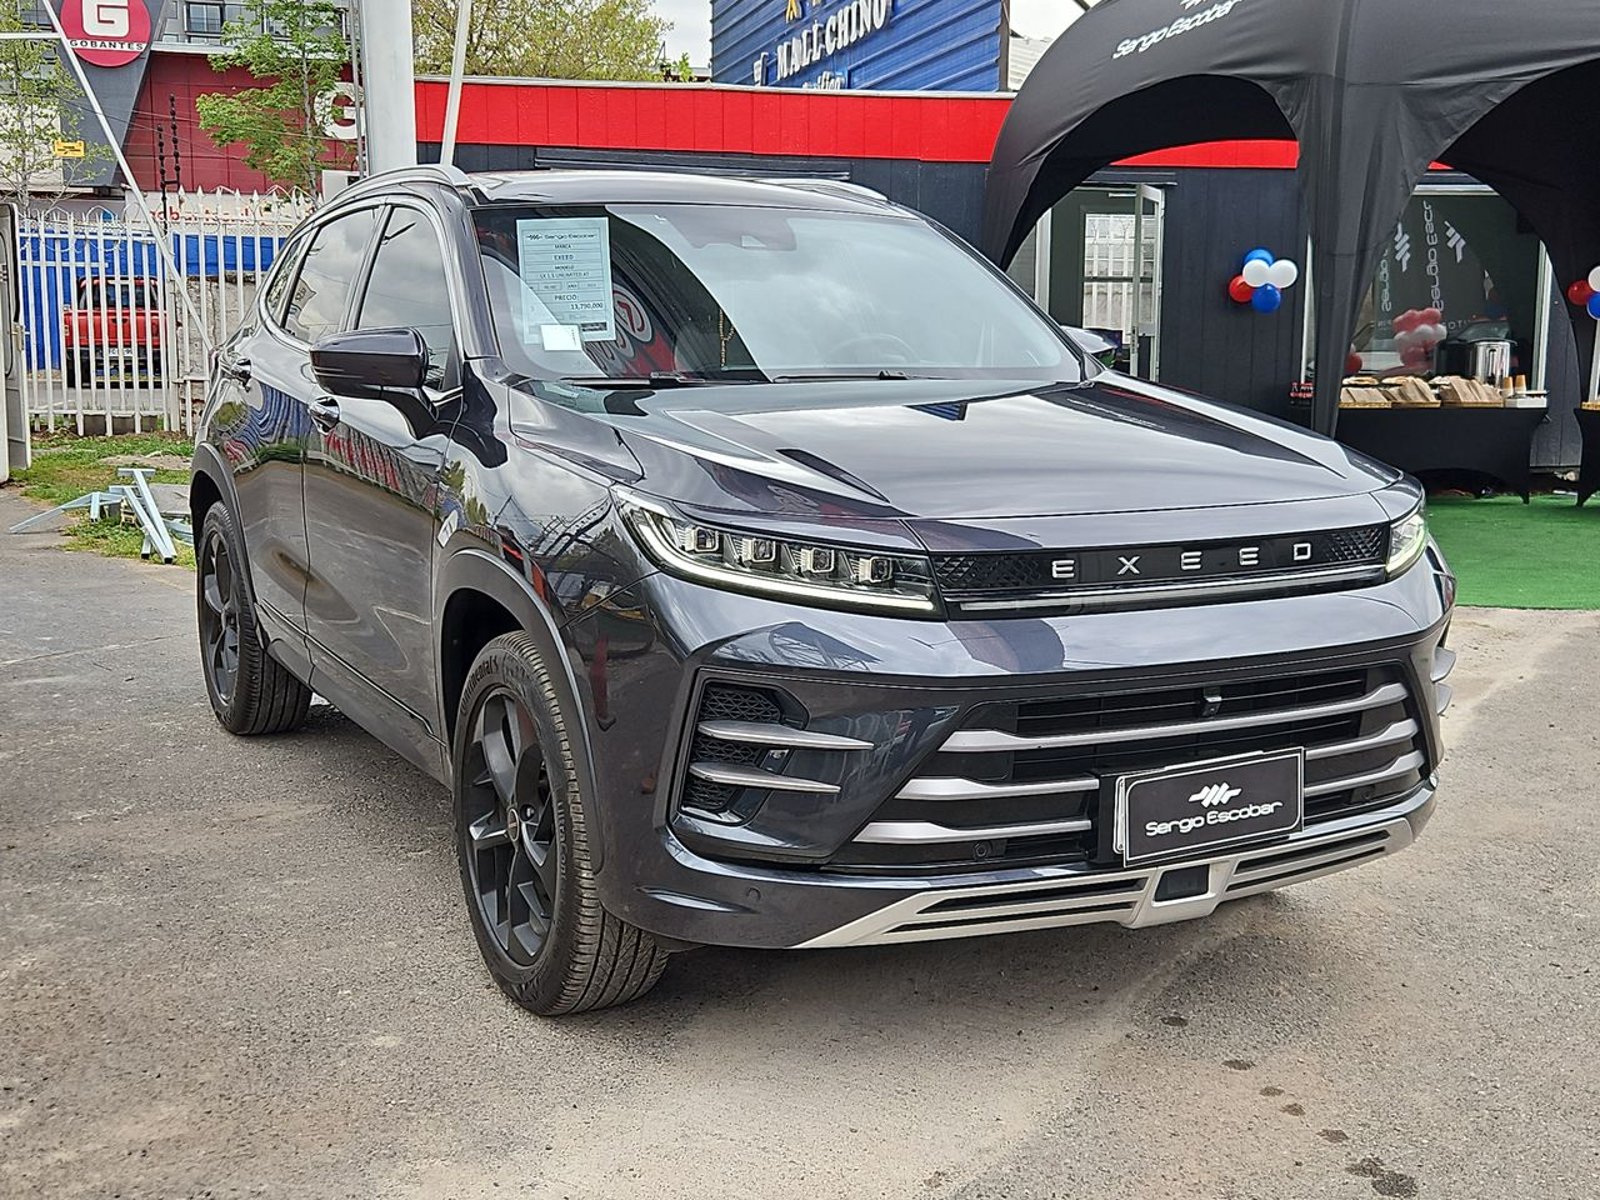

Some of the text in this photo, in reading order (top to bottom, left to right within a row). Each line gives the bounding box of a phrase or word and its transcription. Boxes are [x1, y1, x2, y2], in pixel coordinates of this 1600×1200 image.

[69, 40, 144, 51] GOBANTES
[825, 0, 888, 55] CHINO
[1051, 542, 1312, 579] EXEED
[1144, 800, 1284, 837] Sergio Escobar
